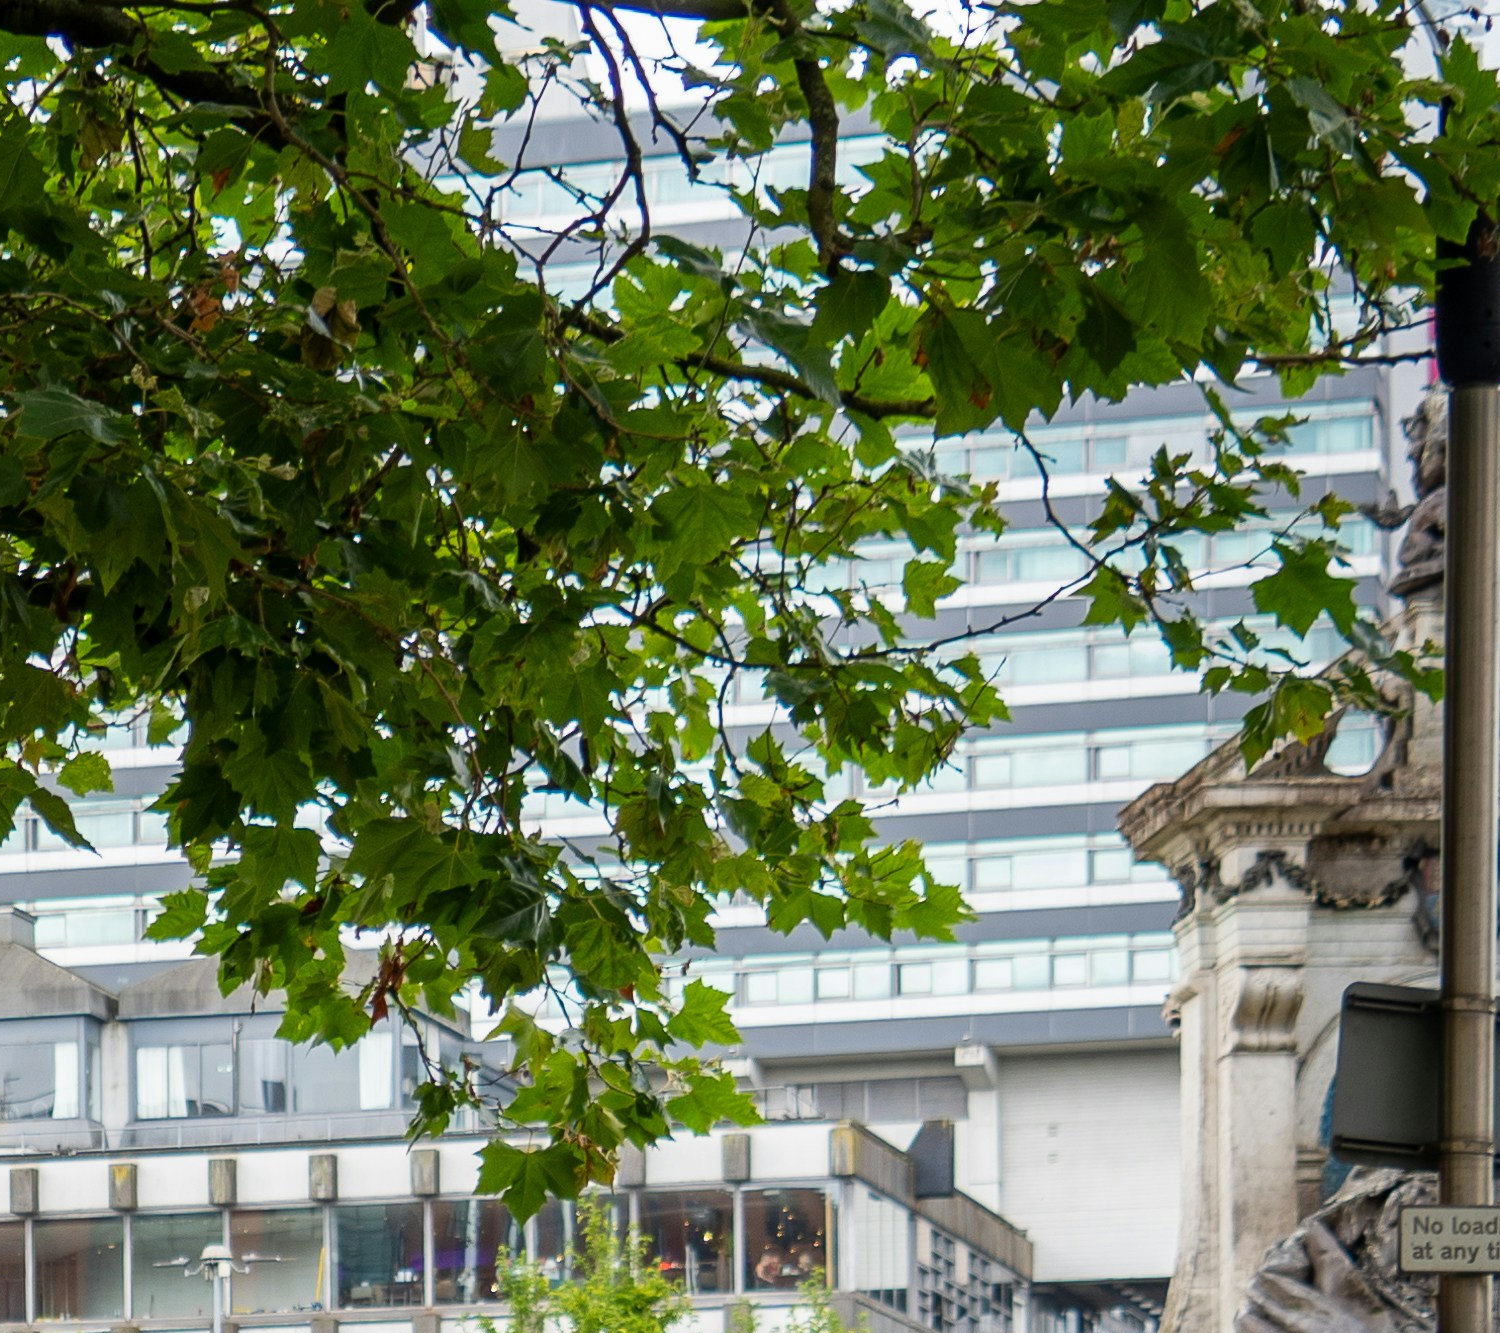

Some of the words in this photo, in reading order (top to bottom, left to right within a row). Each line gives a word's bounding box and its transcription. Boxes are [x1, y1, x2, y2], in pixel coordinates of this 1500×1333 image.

[1413, 1216, 1443, 1235] No
[1412, 1242, 1433, 1260] at
[1441, 1245, 1479, 1264] any
